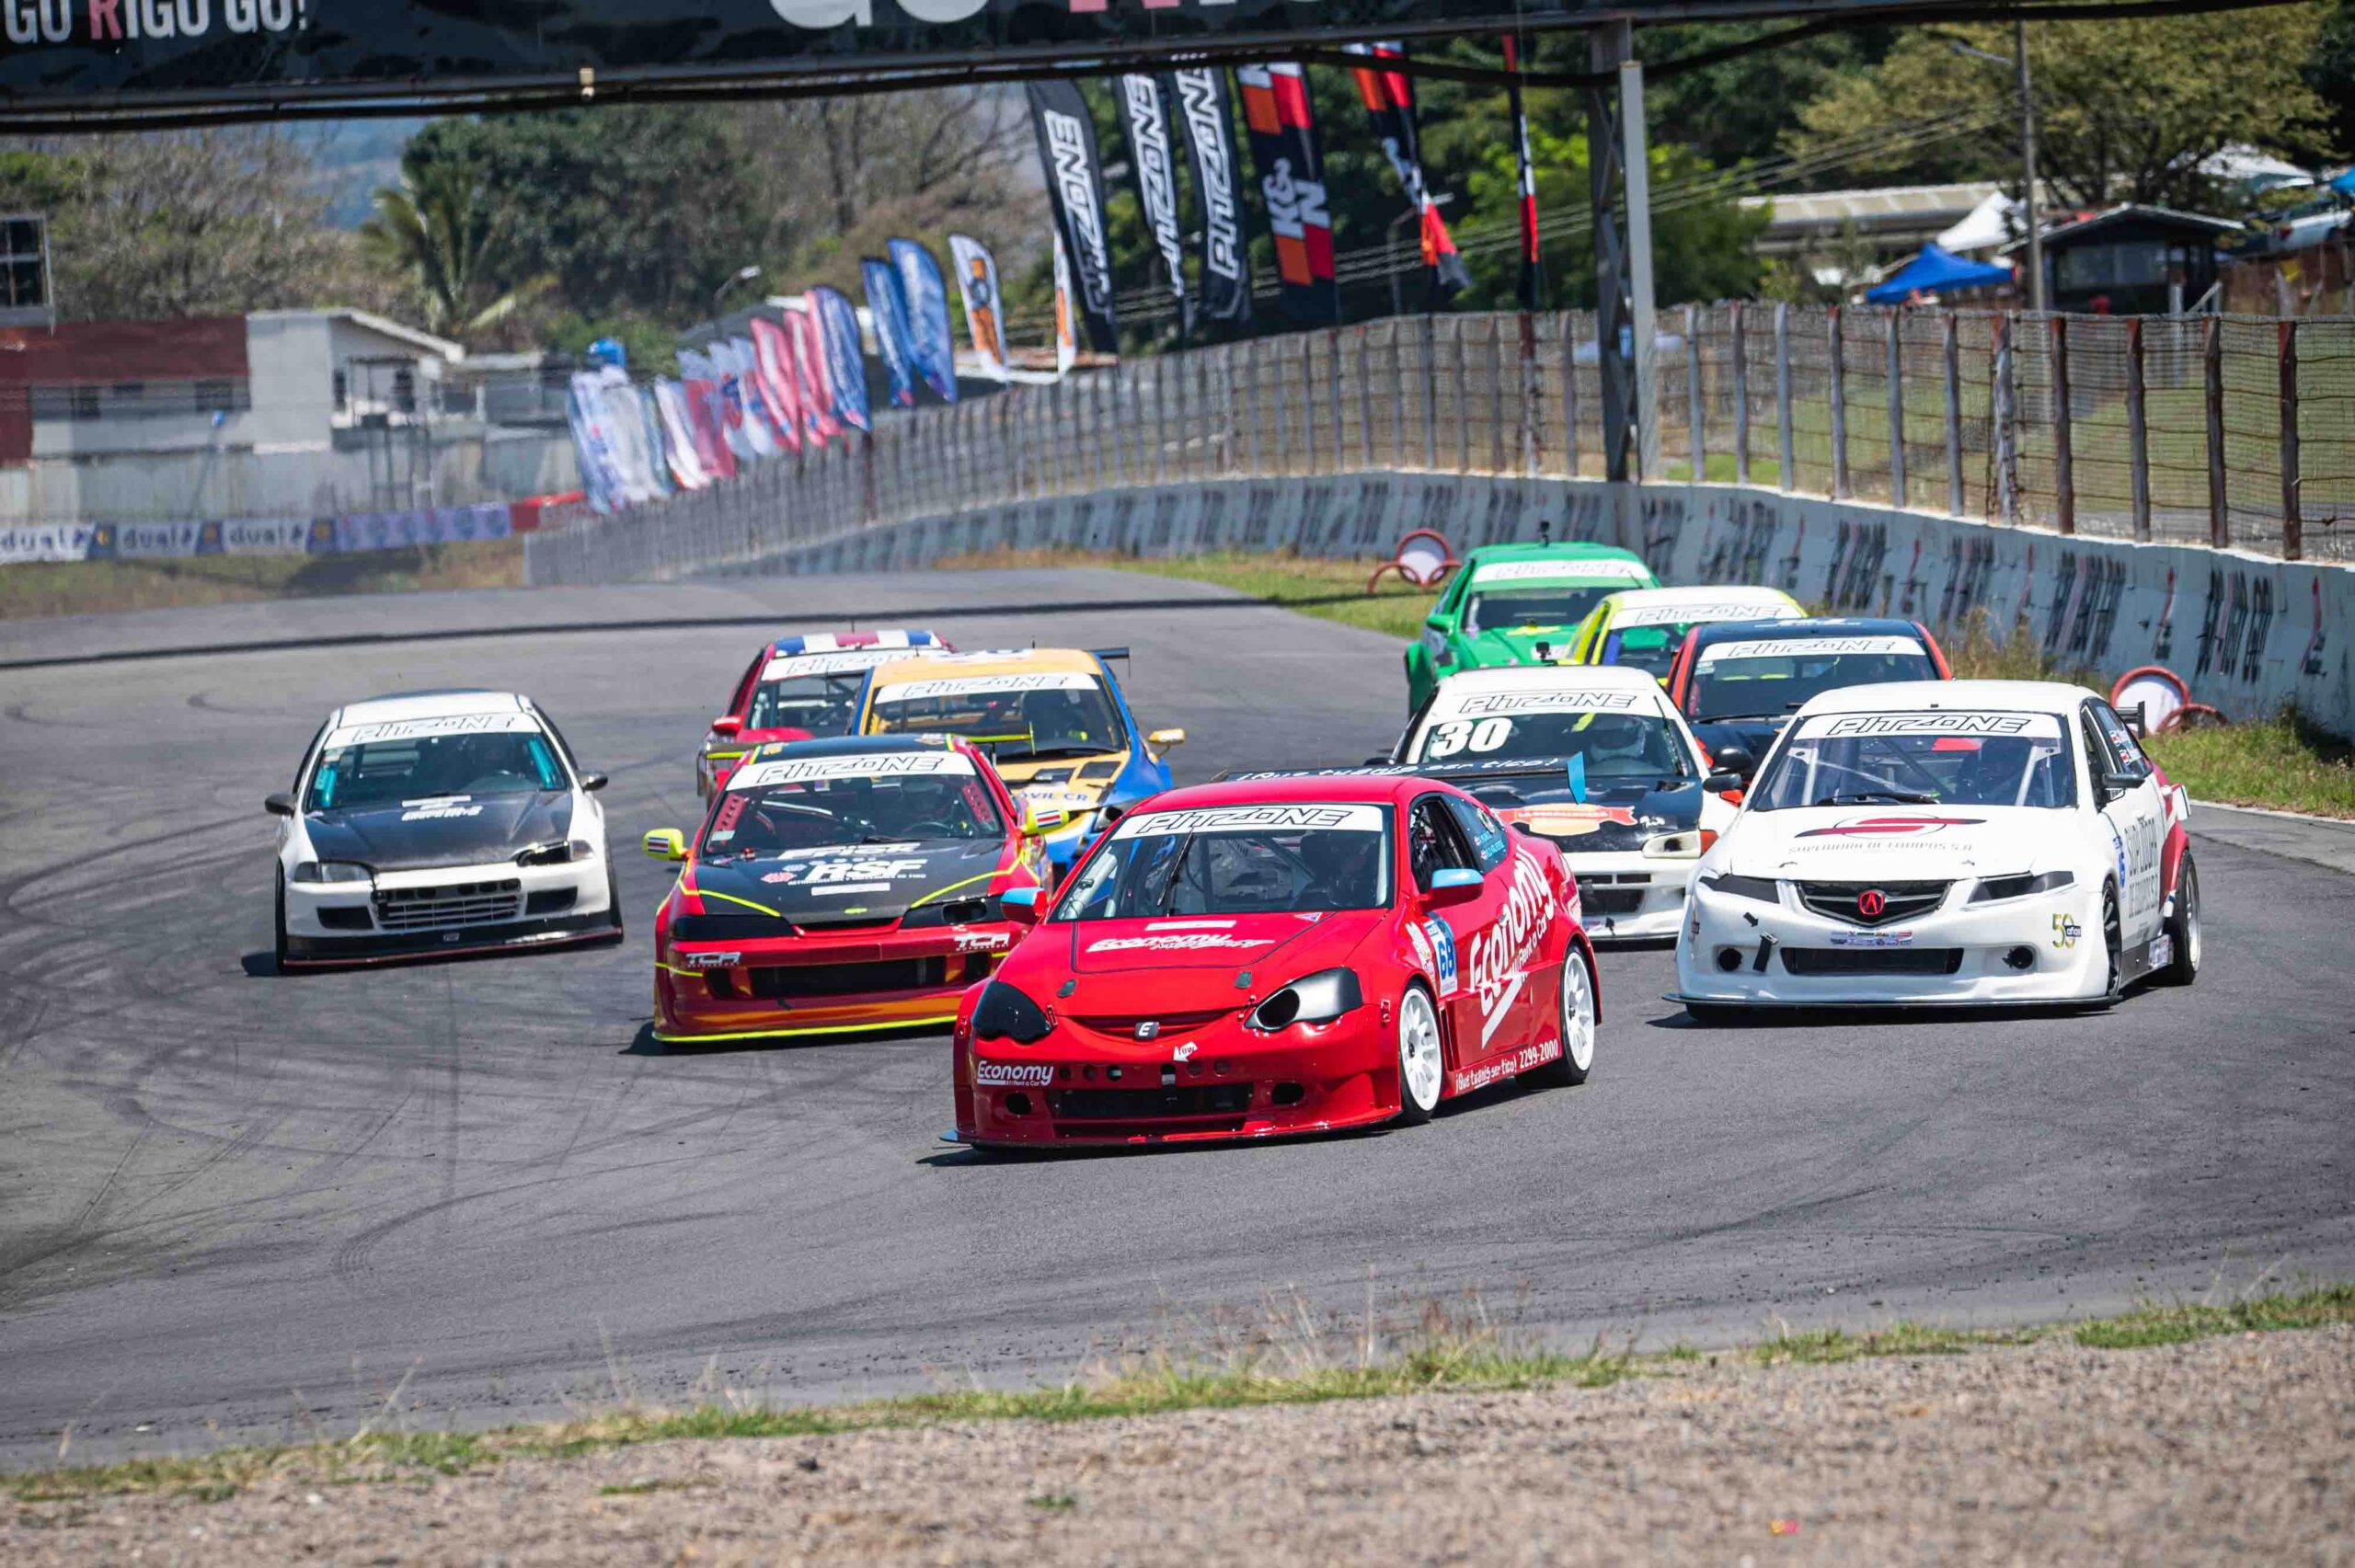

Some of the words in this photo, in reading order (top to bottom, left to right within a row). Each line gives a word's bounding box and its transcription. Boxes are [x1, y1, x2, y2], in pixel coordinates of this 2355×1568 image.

[4, 0, 72, 43] GO
[88, 0, 210, 40] RIGO
[1637, 605, 1781, 624] PITZONE
[1729, 638, 1896, 658] PITZONE
[902, 674, 1069, 698] PITZONE
[1459, 692, 1637, 715] PITZONE
[1430, 716, 1513, 758] 30
[1825, 715, 2031, 736] PITZONE
[758, 755, 945, 784] PITZONE
[1136, 807, 1354, 834] PITZONE
[803, 858, 928, 881] RSF
[1468, 842, 1555, 1016] Economy
[1437, 936, 1455, 980] 68
[1138, 1022, 1154, 1036] E
[1519, 1038, 1559, 1070] 2299-2000
[977, 1059, 1055, 1086] Economy
